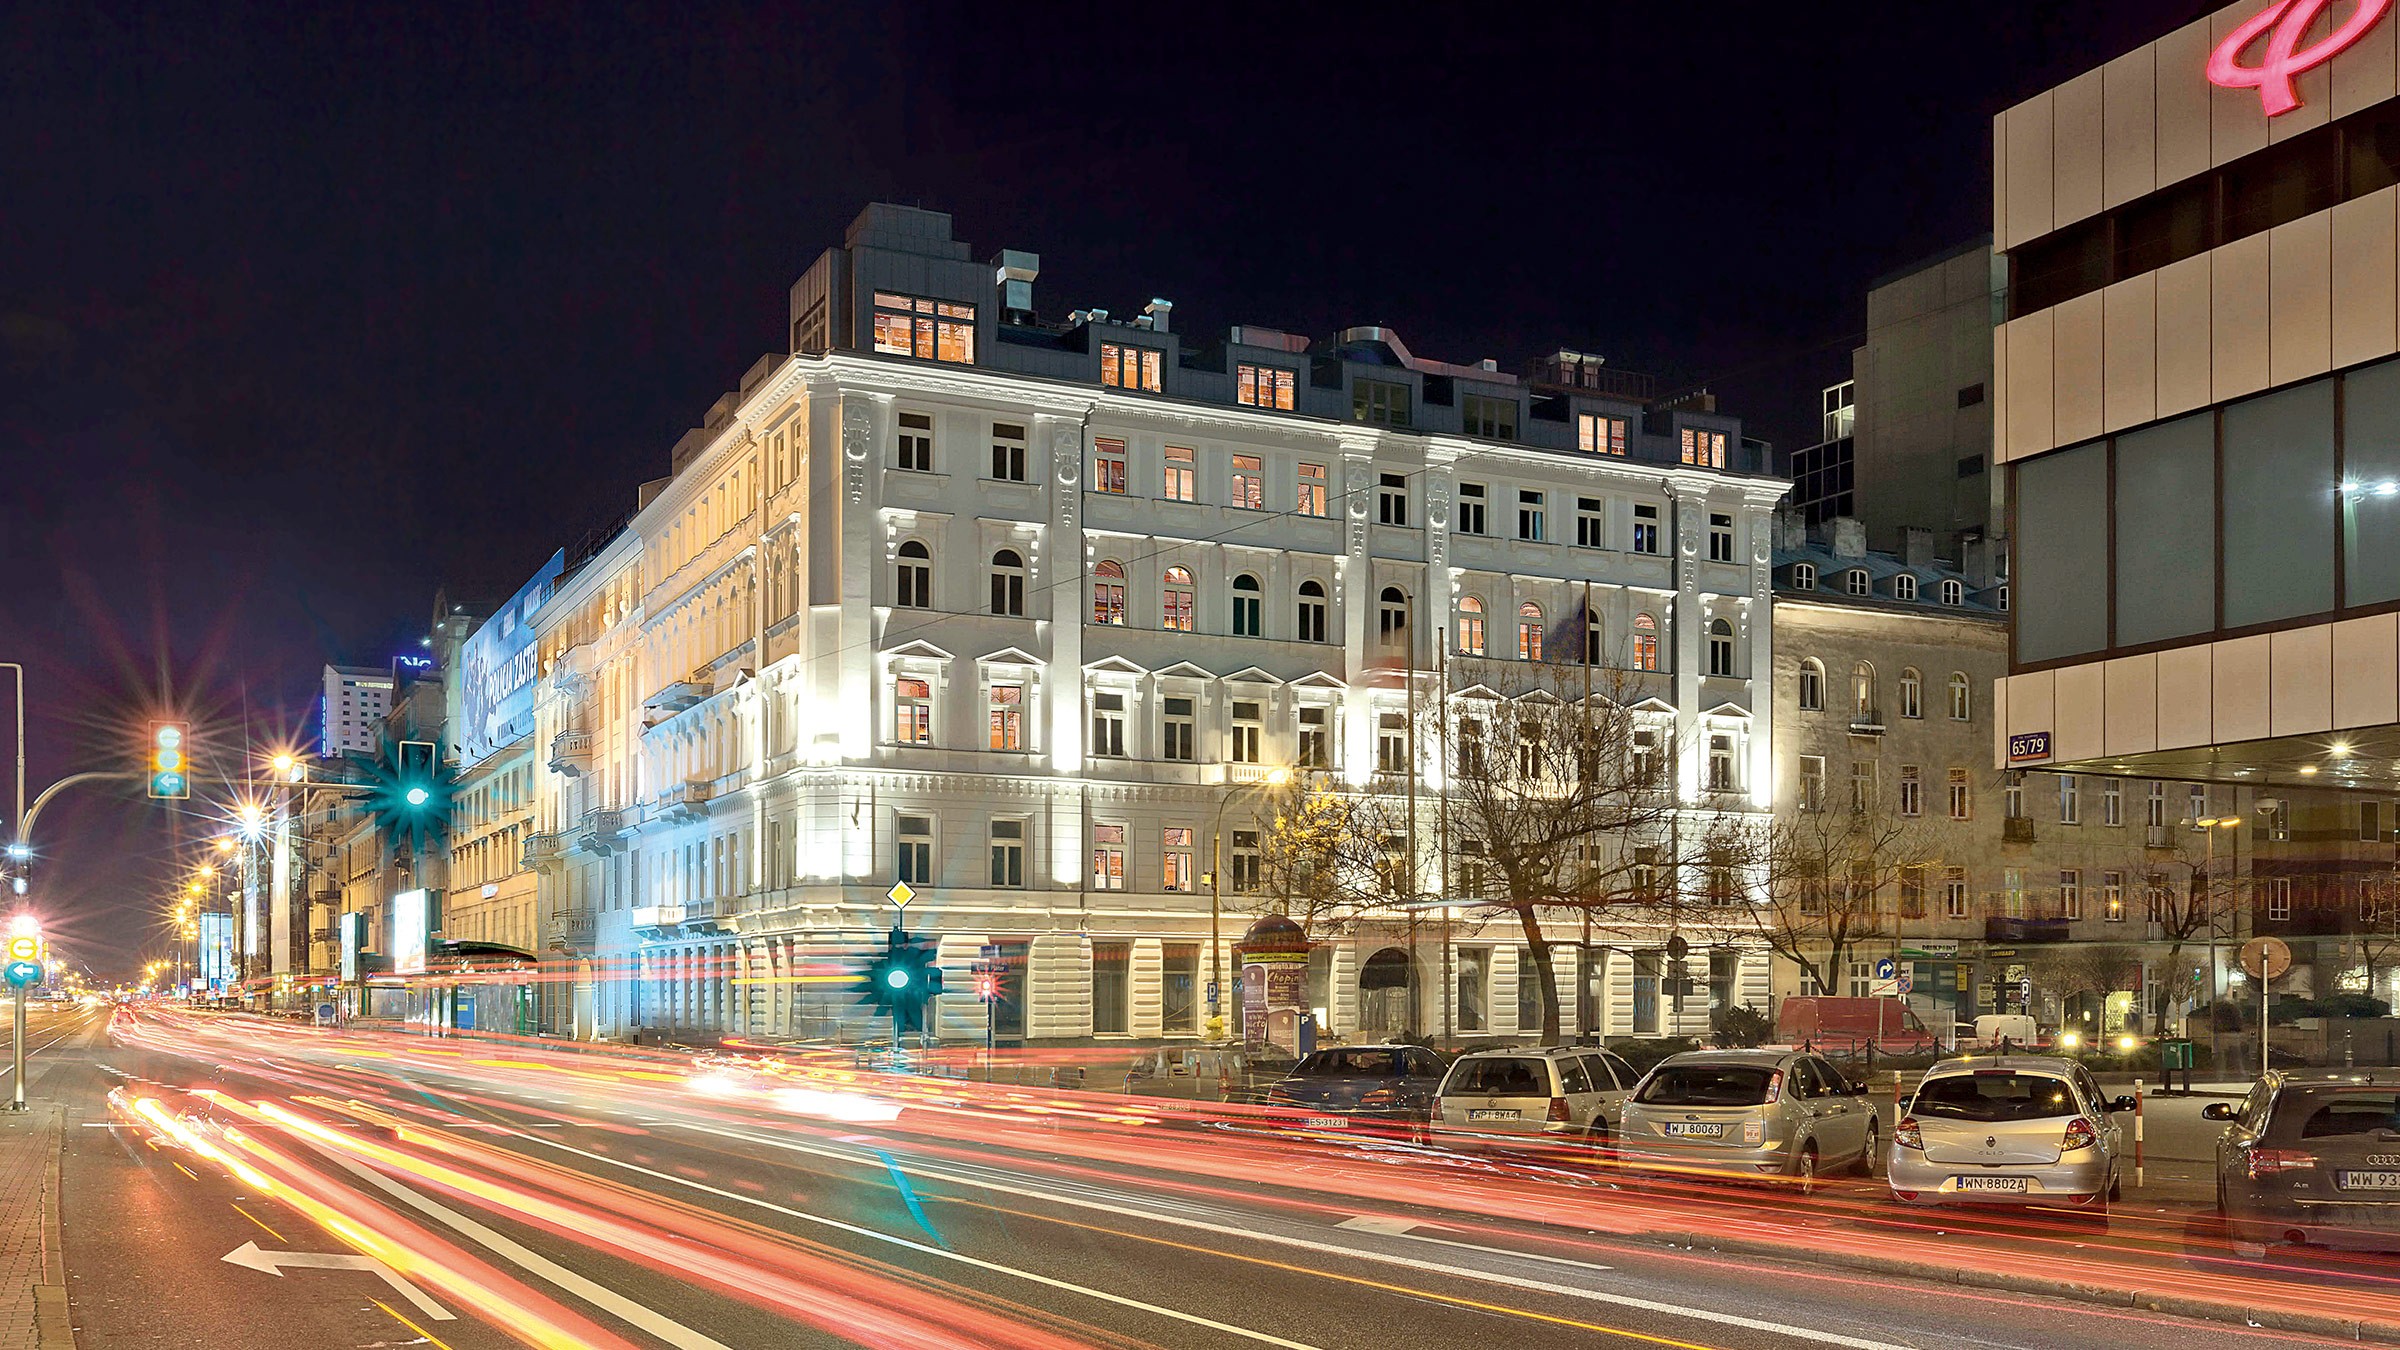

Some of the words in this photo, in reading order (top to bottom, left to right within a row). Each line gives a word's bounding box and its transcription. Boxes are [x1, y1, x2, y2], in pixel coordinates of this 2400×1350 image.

[2012, 738, 2044, 756] 65/79
[1267, 971, 1299, 984] Chopin
[1301, 1016, 1309, 1025] P
[1672, 1124, 1685, 1133] WJ
[1689, 1124, 1720, 1134] 80063
[1965, 1178, 1983, 1188] WN
[1986, 1178, 2024, 1190] 8802A
[2350, 1173, 2372, 1185] WW
